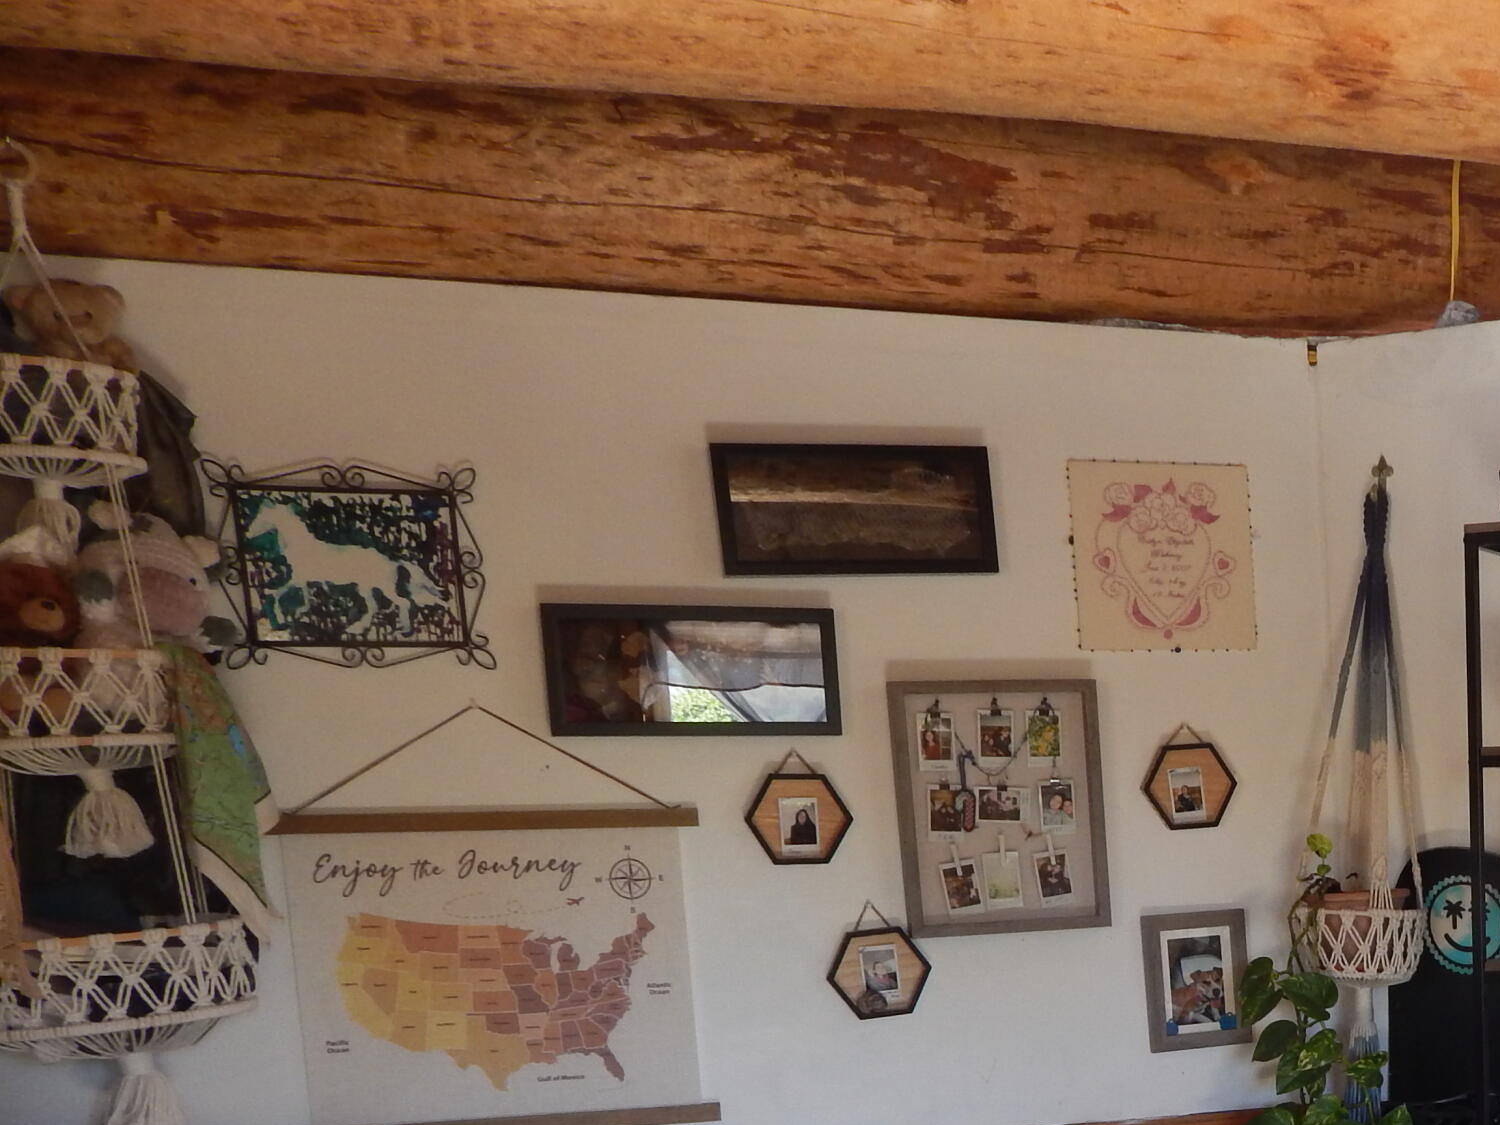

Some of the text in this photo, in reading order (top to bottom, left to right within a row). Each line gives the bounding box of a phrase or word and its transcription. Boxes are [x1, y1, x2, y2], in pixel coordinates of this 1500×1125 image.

[314, 849, 583, 898] Enjoy the Journey
